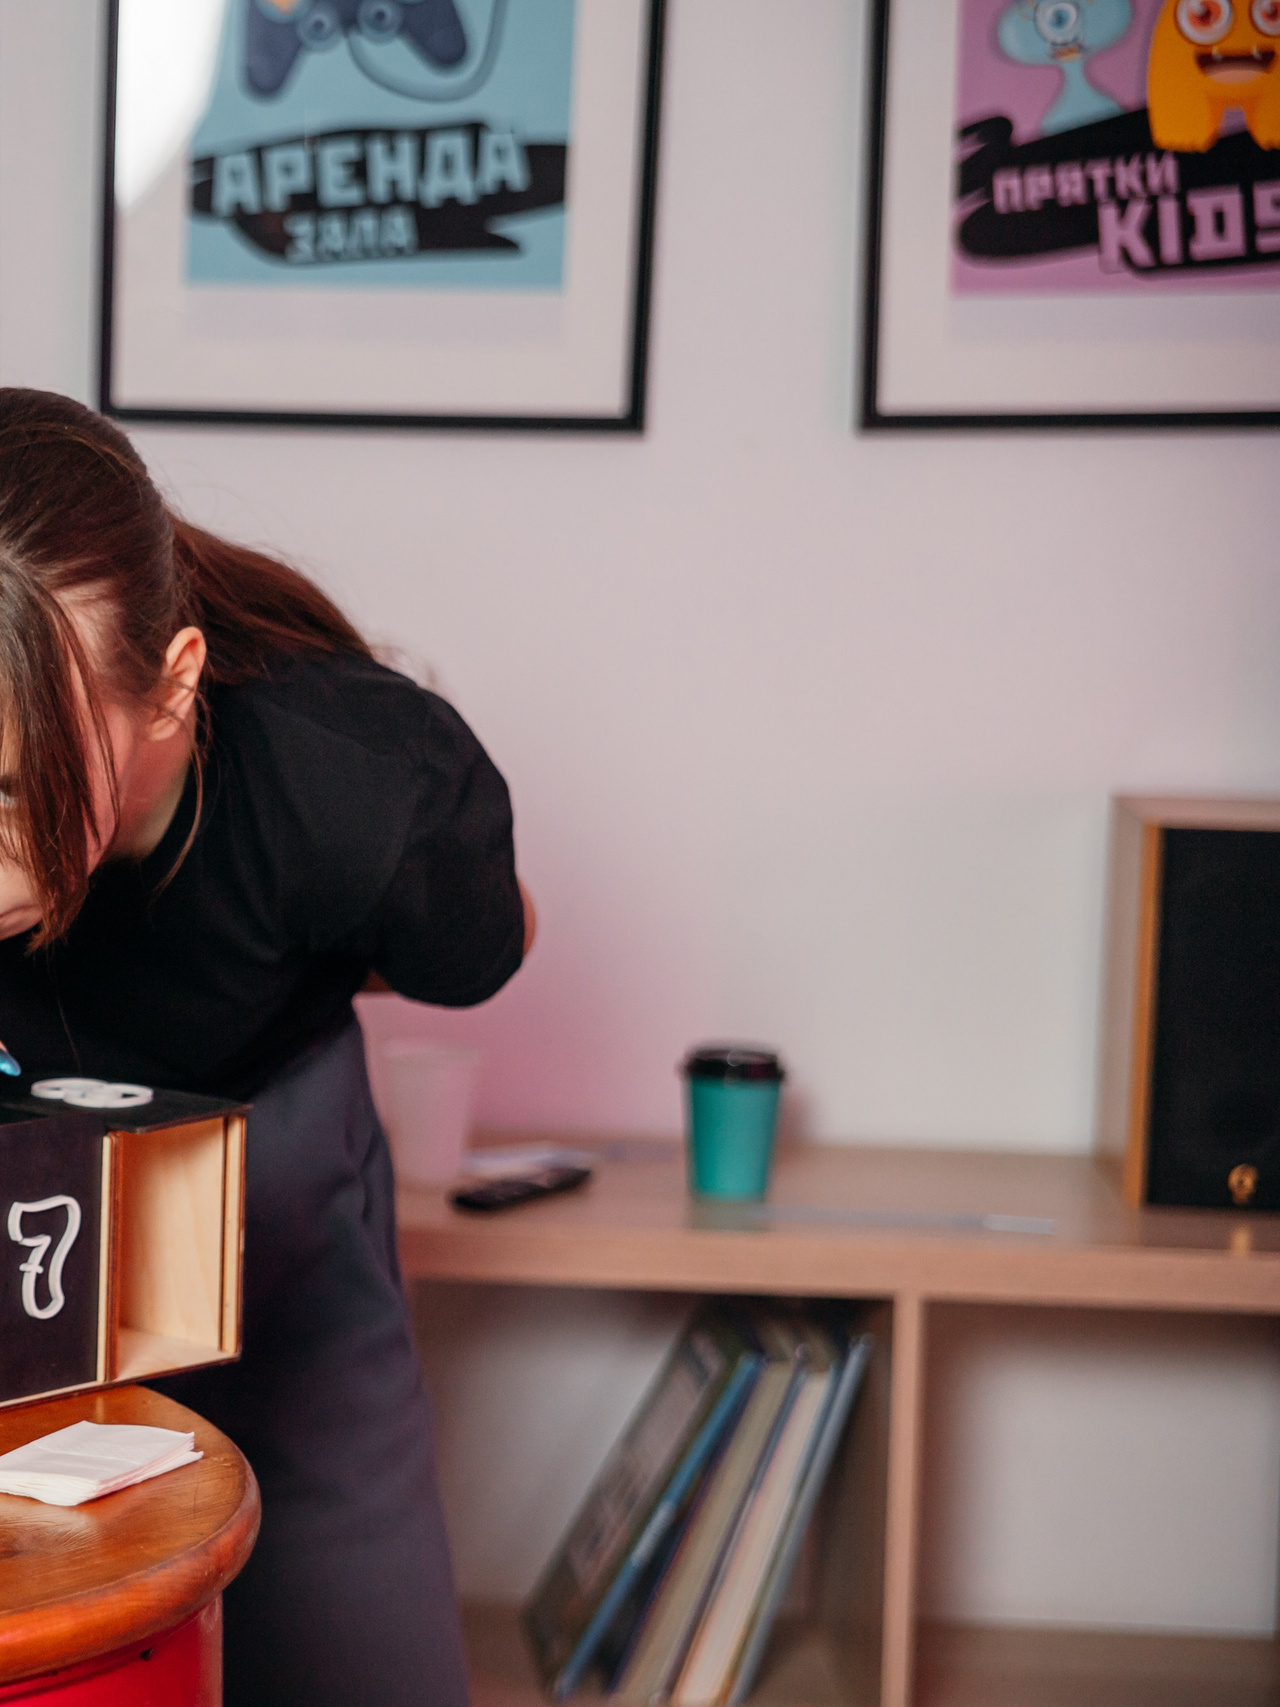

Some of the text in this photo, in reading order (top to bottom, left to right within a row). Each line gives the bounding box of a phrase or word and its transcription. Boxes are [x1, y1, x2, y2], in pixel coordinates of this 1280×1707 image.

[212, 126, 532, 217] АРЕНДА
[992, 151, 1180, 214] ПРЯТКИ
[283, 206, 419, 265] ЗАЛА
[7, 1194, 82, 1320] 7
